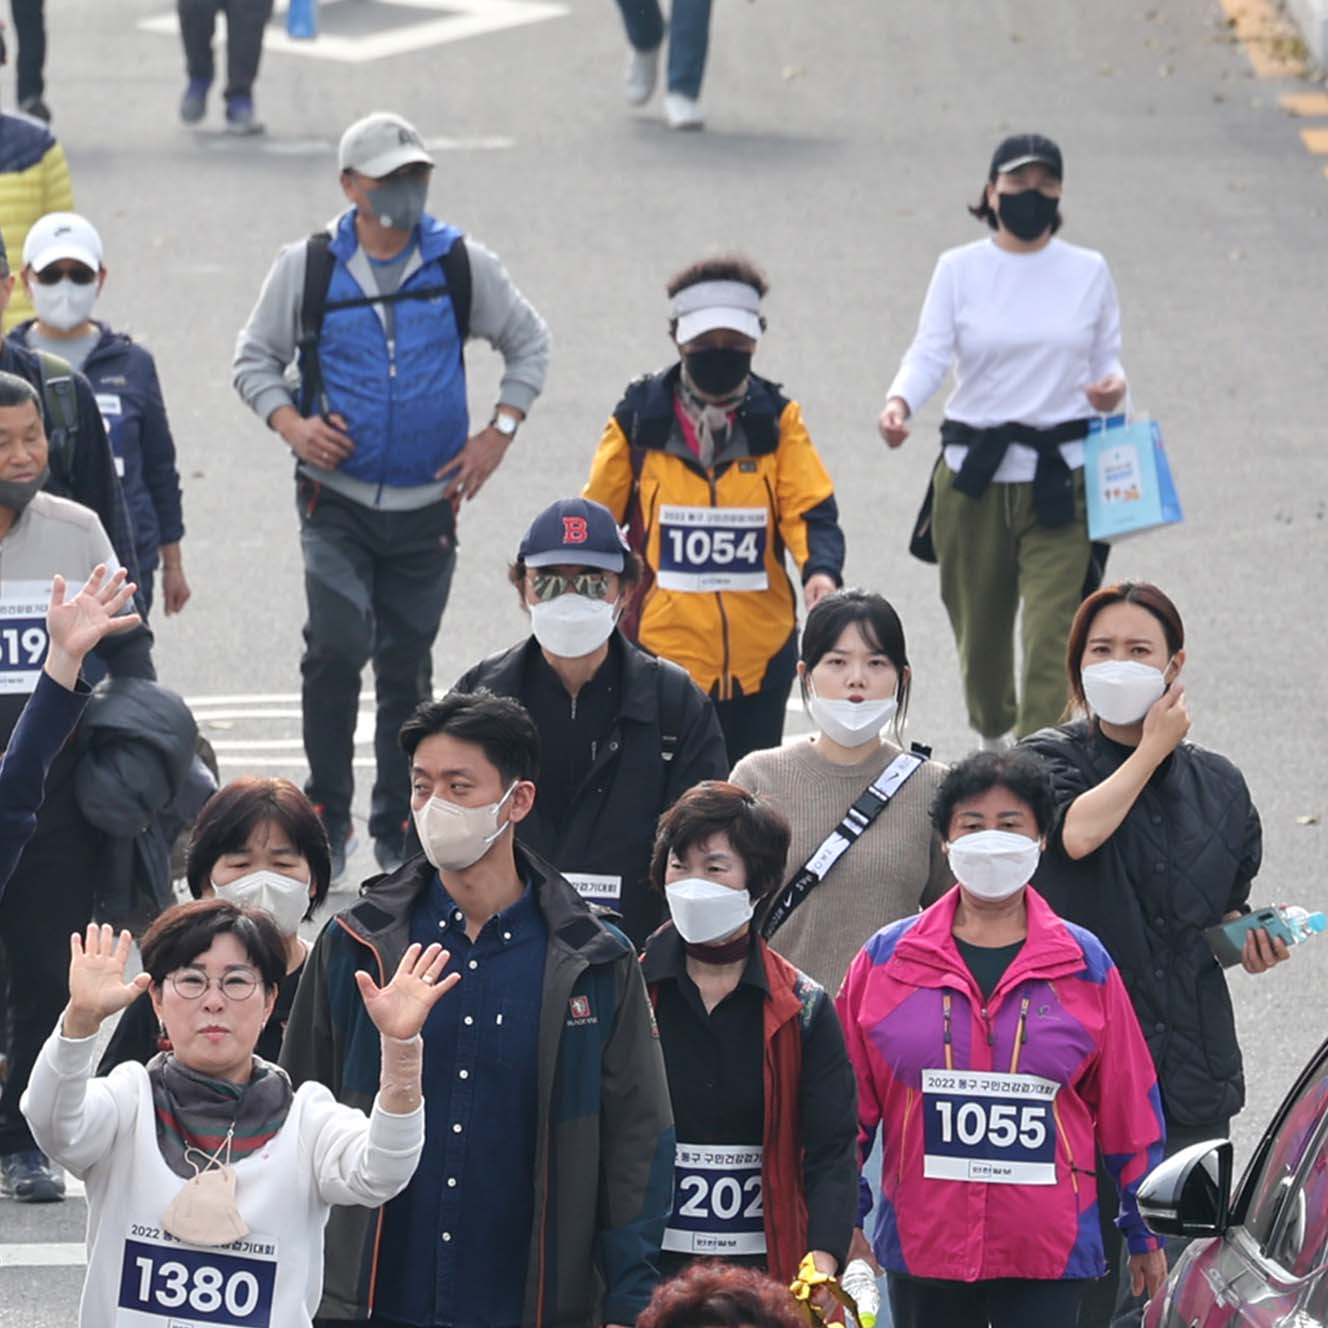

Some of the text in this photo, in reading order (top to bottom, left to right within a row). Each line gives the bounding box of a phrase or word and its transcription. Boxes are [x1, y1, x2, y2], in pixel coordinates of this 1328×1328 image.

[562, 516, 588, 544] B
[669, 529, 758, 565] 1054
[928, 1077, 955, 1089] 2022
[958, 1078, 977, 1090] 동구
[935, 1101, 1046, 1149] 1055
[703, 1152, 763, 1165] 구민건강걷기
[679, 1175, 763, 1219] 202
[131, 1224, 161, 1240] 2022
[136, 1257, 259, 1317] 1380
